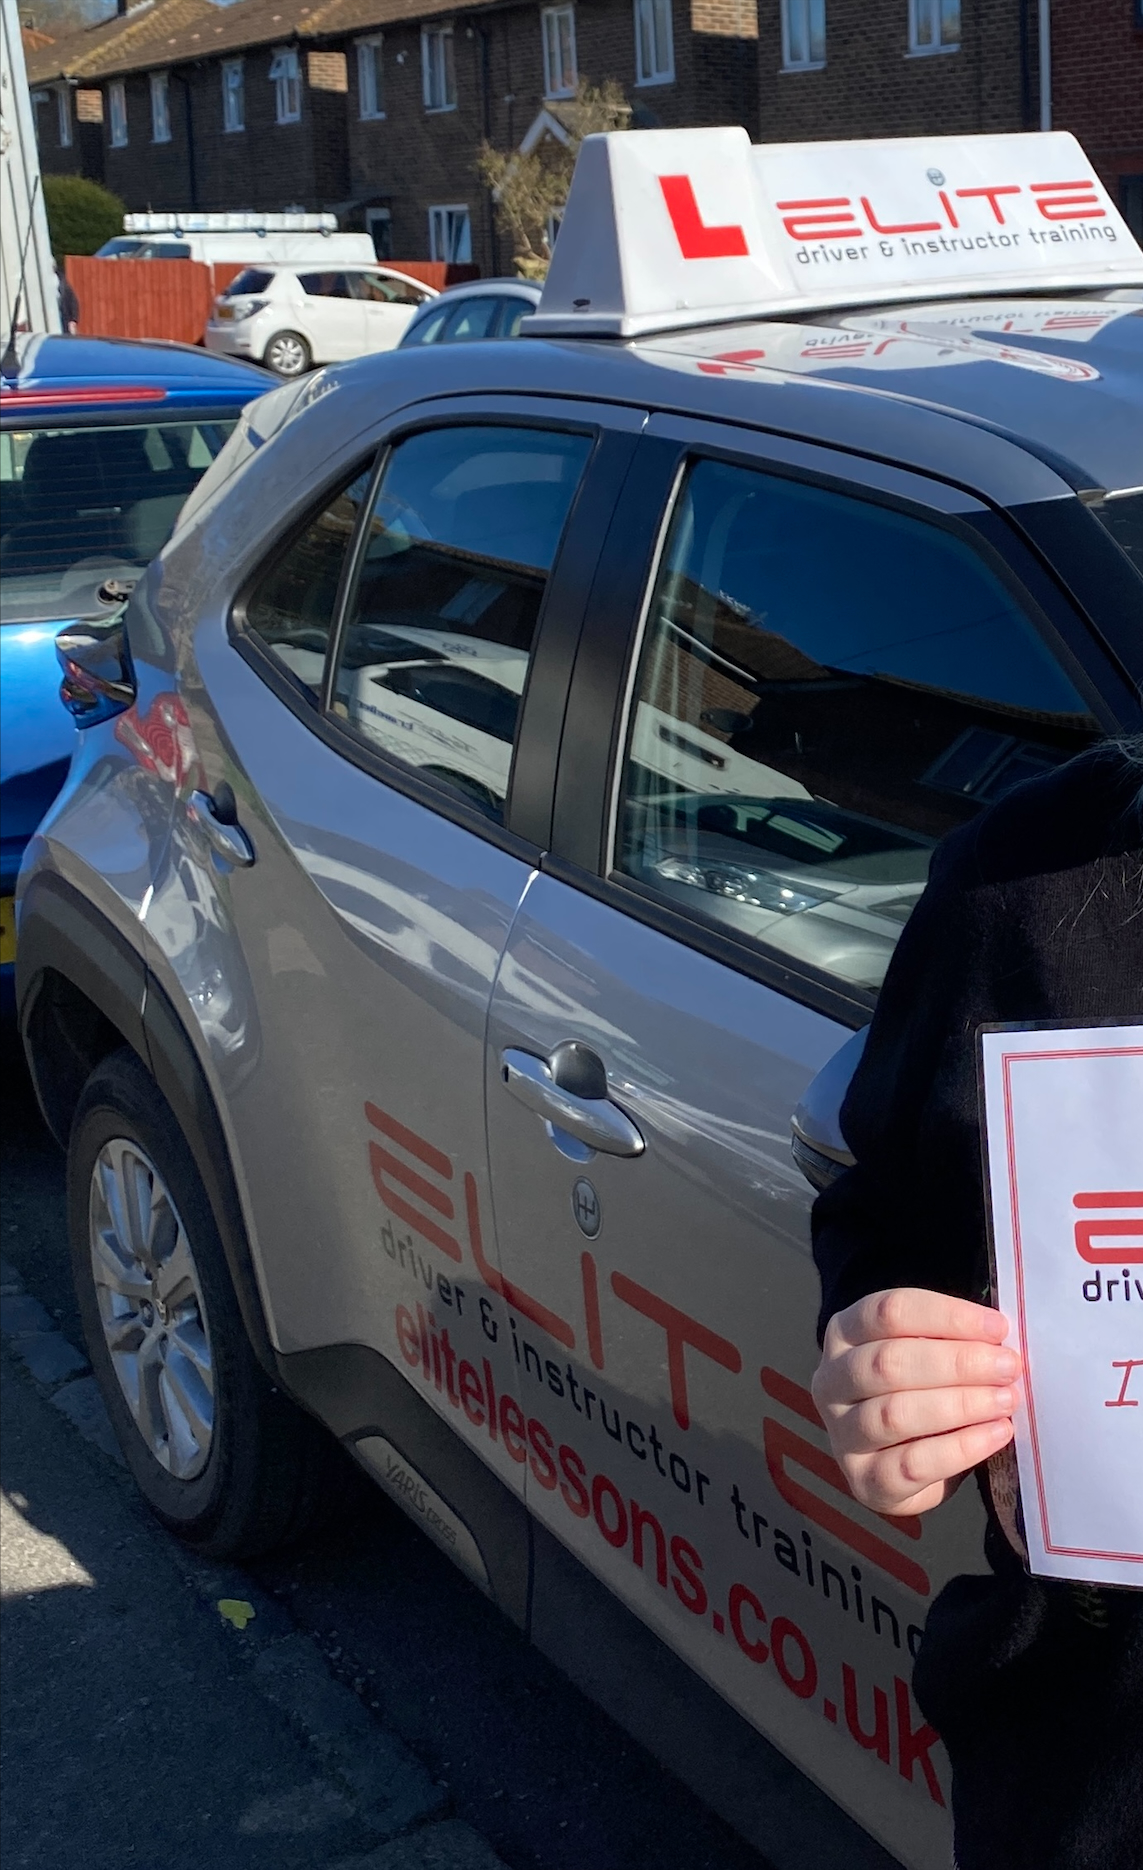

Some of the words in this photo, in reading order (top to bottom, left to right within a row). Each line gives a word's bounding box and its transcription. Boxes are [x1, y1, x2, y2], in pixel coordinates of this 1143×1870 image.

[658, 175, 749, 260] L
[776, 181, 1106, 241] ELITE
[796, 243, 868, 265] driver
[878, 241, 894, 258] &
[901, 231, 1021, 256] instructor
[1028, 223, 1117, 245] training
[364, 1100, 931, 1596] ELITE
[380, 1219, 466, 1316] driver
[479, 1297, 499, 1343] &
[509, 1317, 710, 1505] instructor
[386, 1454, 429, 1513] YARIS
[395, 1301, 947, 1809] elitelessons.co.uk
